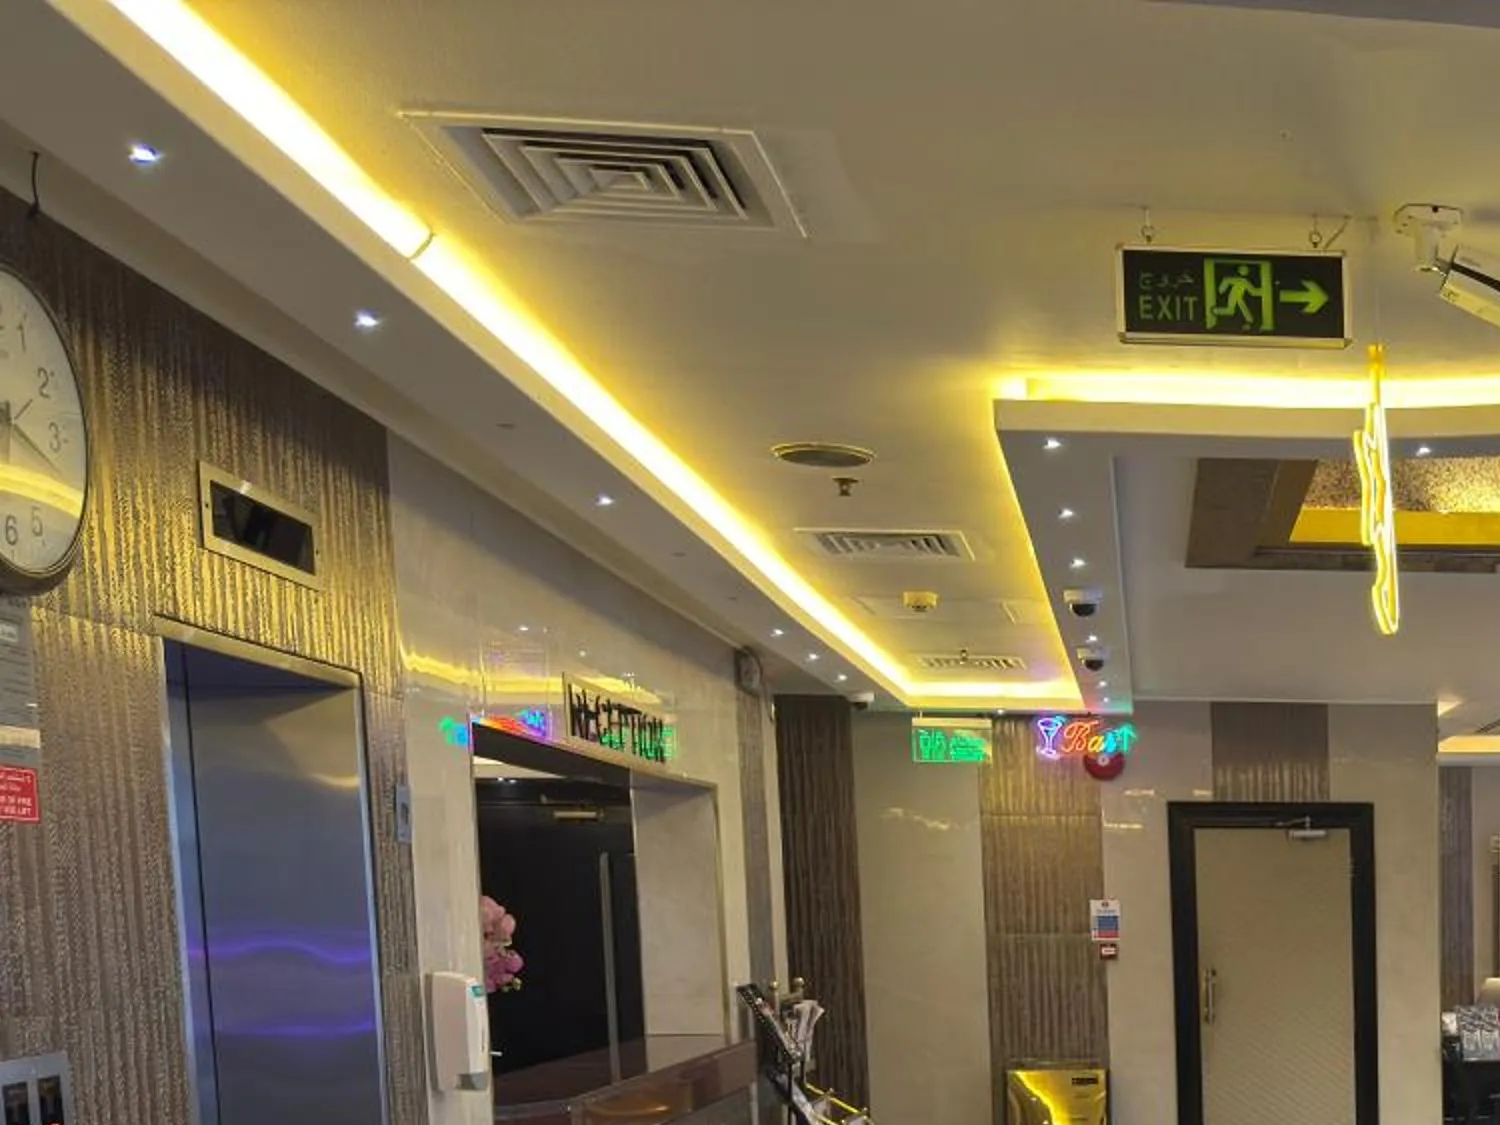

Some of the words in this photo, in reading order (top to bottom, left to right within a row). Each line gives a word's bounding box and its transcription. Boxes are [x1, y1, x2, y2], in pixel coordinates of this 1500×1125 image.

[1138, 295, 1200, 322] EXIT
[37, 367, 51, 399] 2
[48, 421, 62, 453] 3
[5, 514, 19, 546] 6
[31, 505, 44, 538] 5
